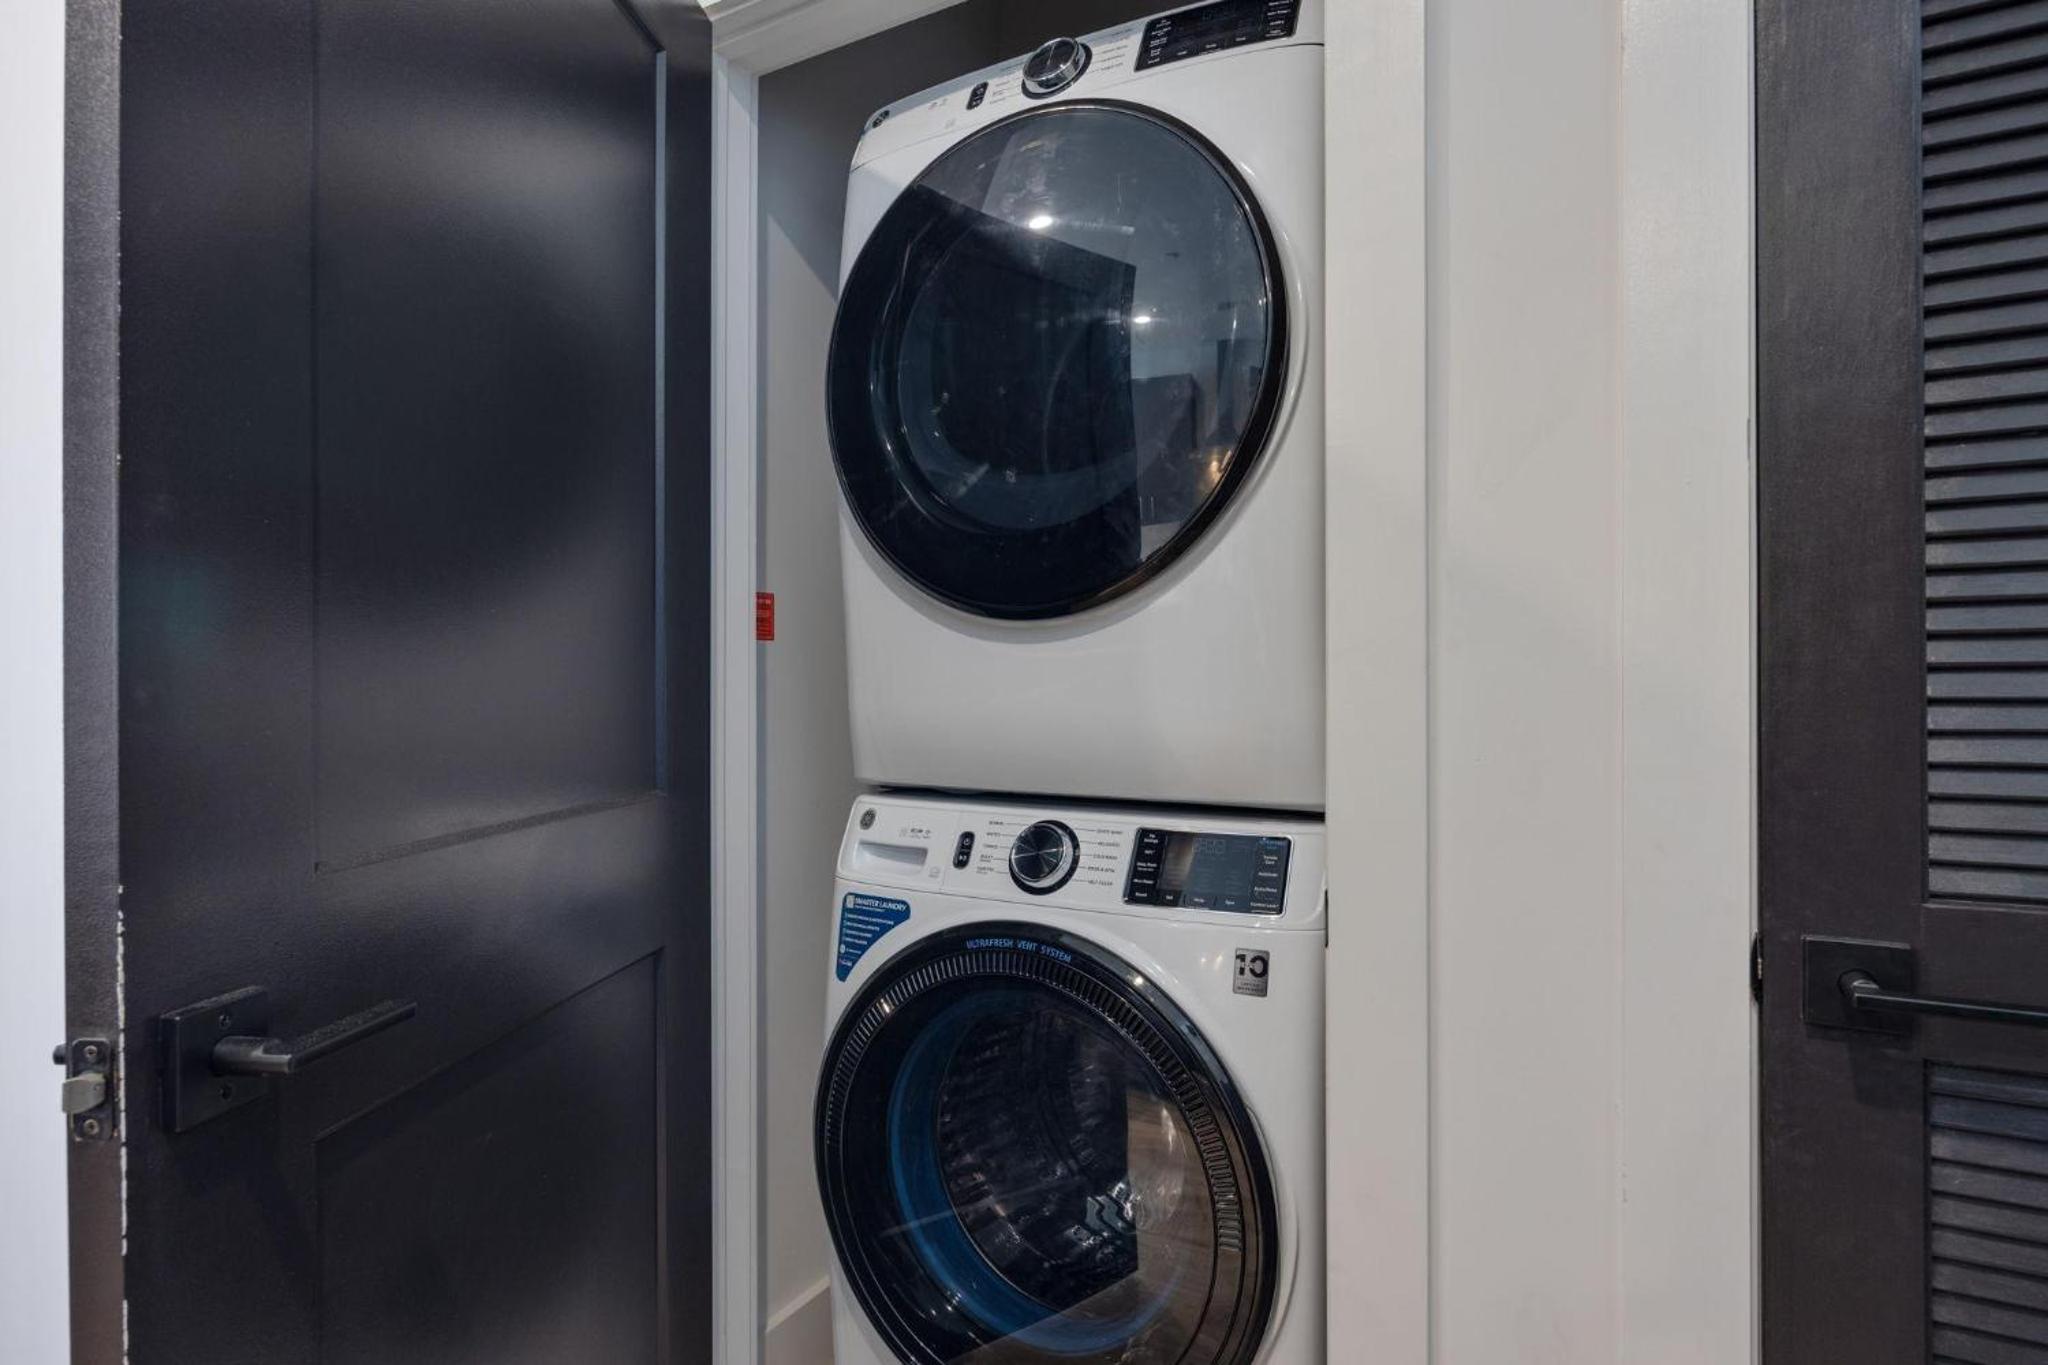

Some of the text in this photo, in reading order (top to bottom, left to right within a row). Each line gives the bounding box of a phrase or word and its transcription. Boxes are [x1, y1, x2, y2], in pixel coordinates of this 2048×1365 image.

[880, 901, 907, 912] LAUNDRY
[966, 938, 1073, 963] ULTRAFRESH VENT SYSTEM
[1235, 954, 1269, 978] 10
